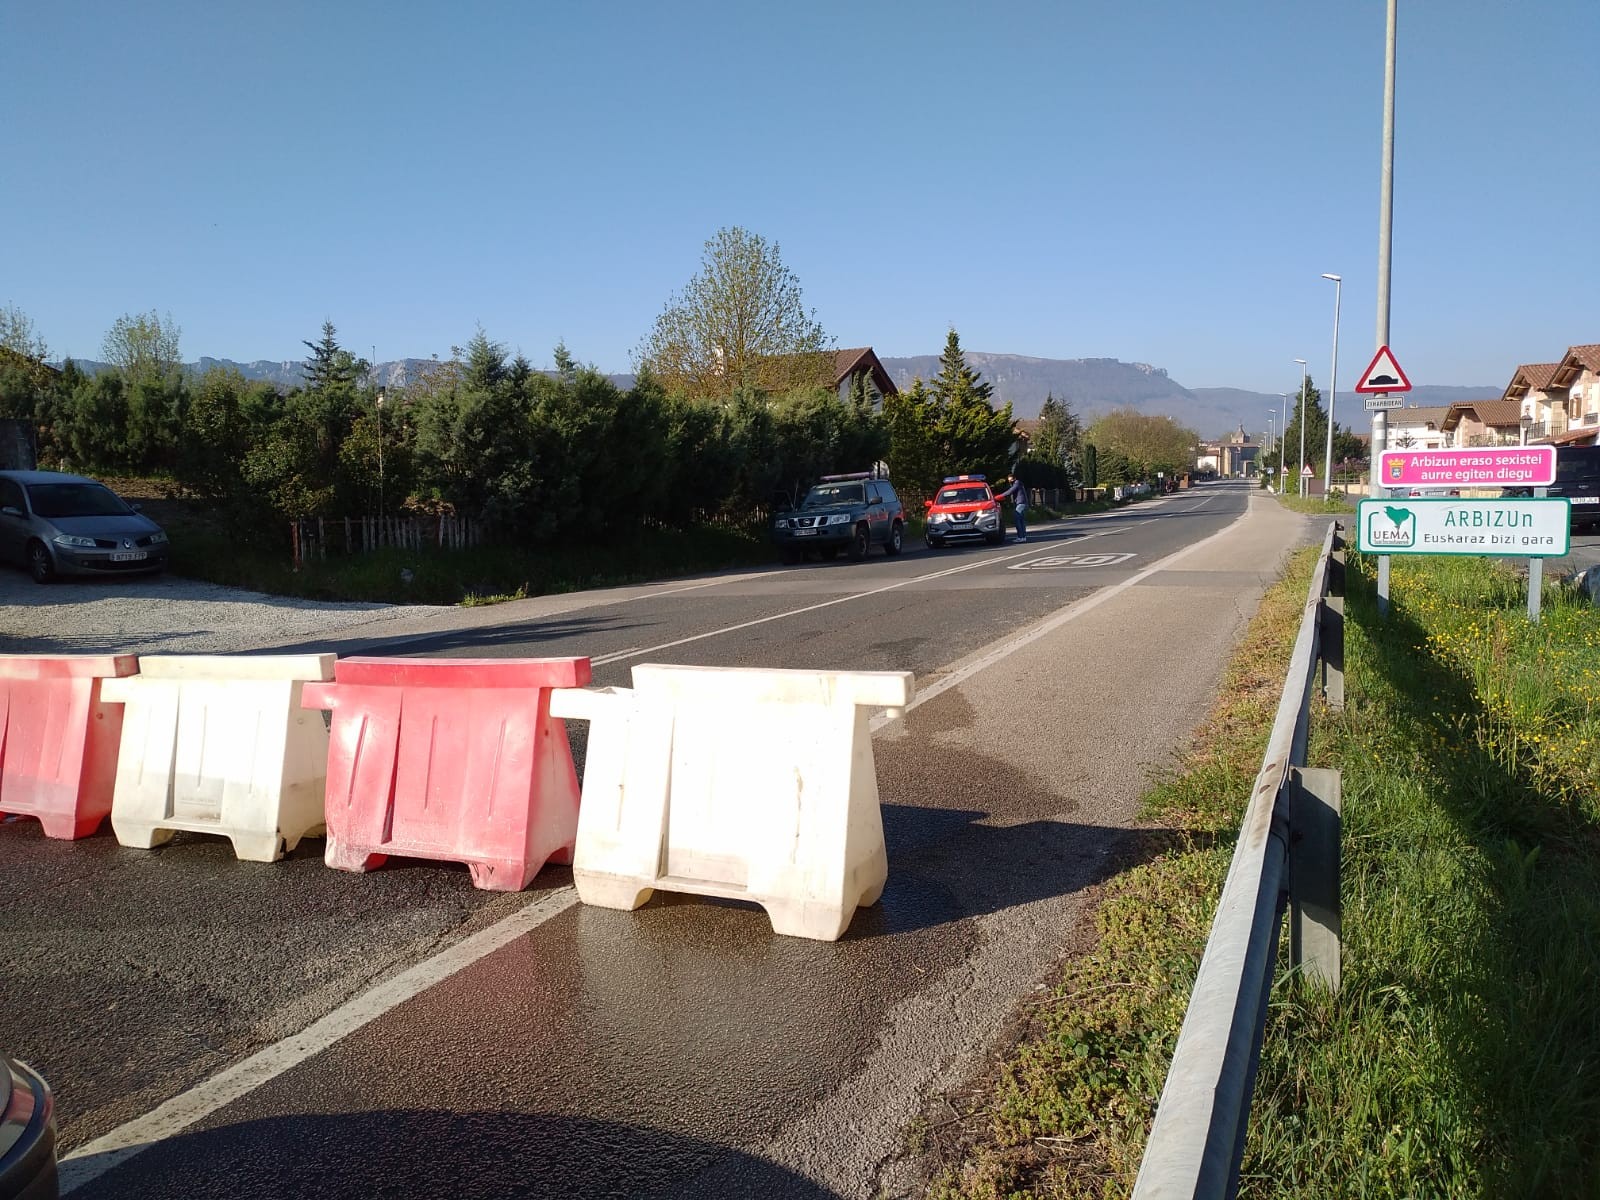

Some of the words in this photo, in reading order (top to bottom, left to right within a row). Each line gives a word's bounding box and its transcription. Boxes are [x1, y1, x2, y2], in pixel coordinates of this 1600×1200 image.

[1410, 455, 1457, 468] Arbizun
[1459, 456, 1493, 466] eraso
[1495, 454, 1542, 465] sexistei
[1421, 471, 1451, 481] aurre
[1454, 469, 1494, 482] egiten
[1499, 468, 1533, 480] diegu
[1444, 510, 1533, 528] ARBIZUn
[1373, 530, 1410, 540] UEMA
[1424, 533, 1485, 544] Euskaraz
[1491, 533, 1516, 545] bizi
[1521, 536, 1554, 546] gara
